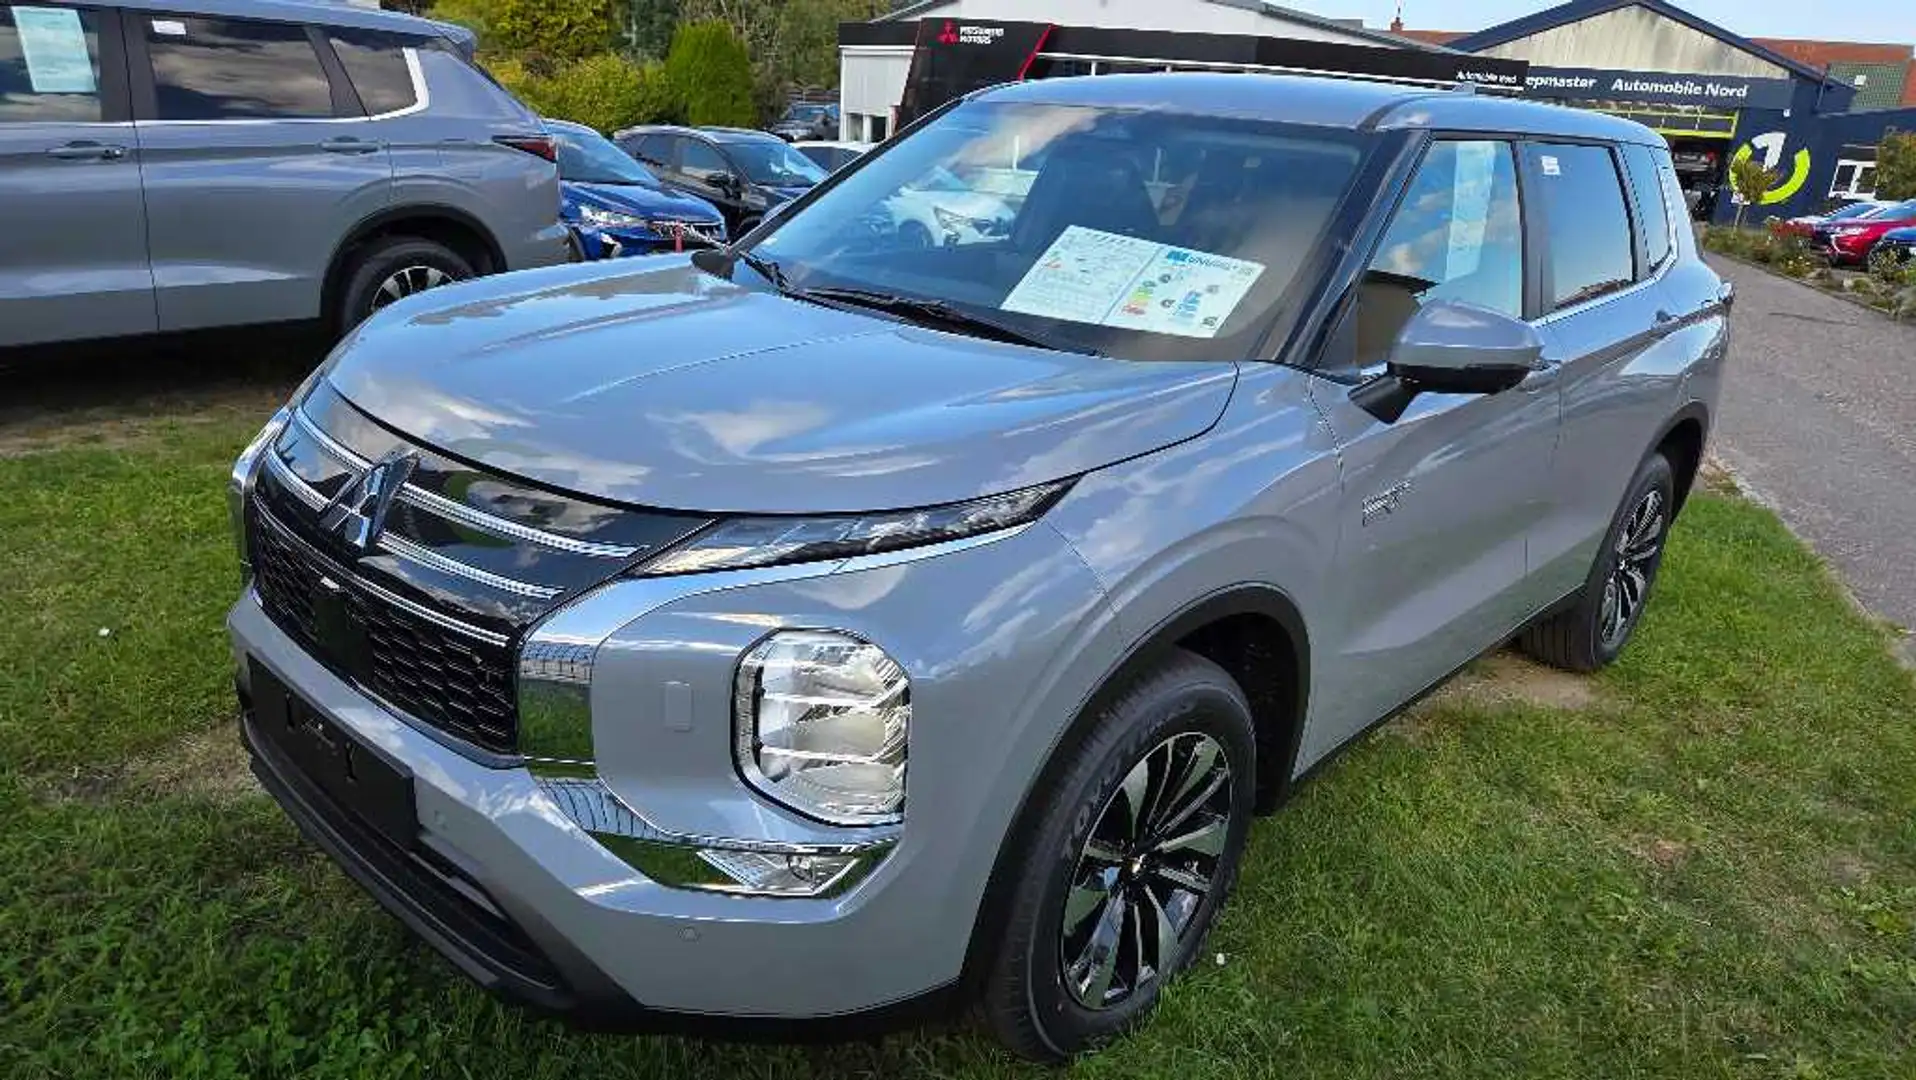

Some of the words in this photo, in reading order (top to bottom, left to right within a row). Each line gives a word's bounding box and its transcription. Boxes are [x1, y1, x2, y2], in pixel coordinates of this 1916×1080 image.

[1525, 76, 1597, 89] epmaster
[1611, 78, 1702, 95] Automobile
[1705, 82, 1749, 97] Nord
